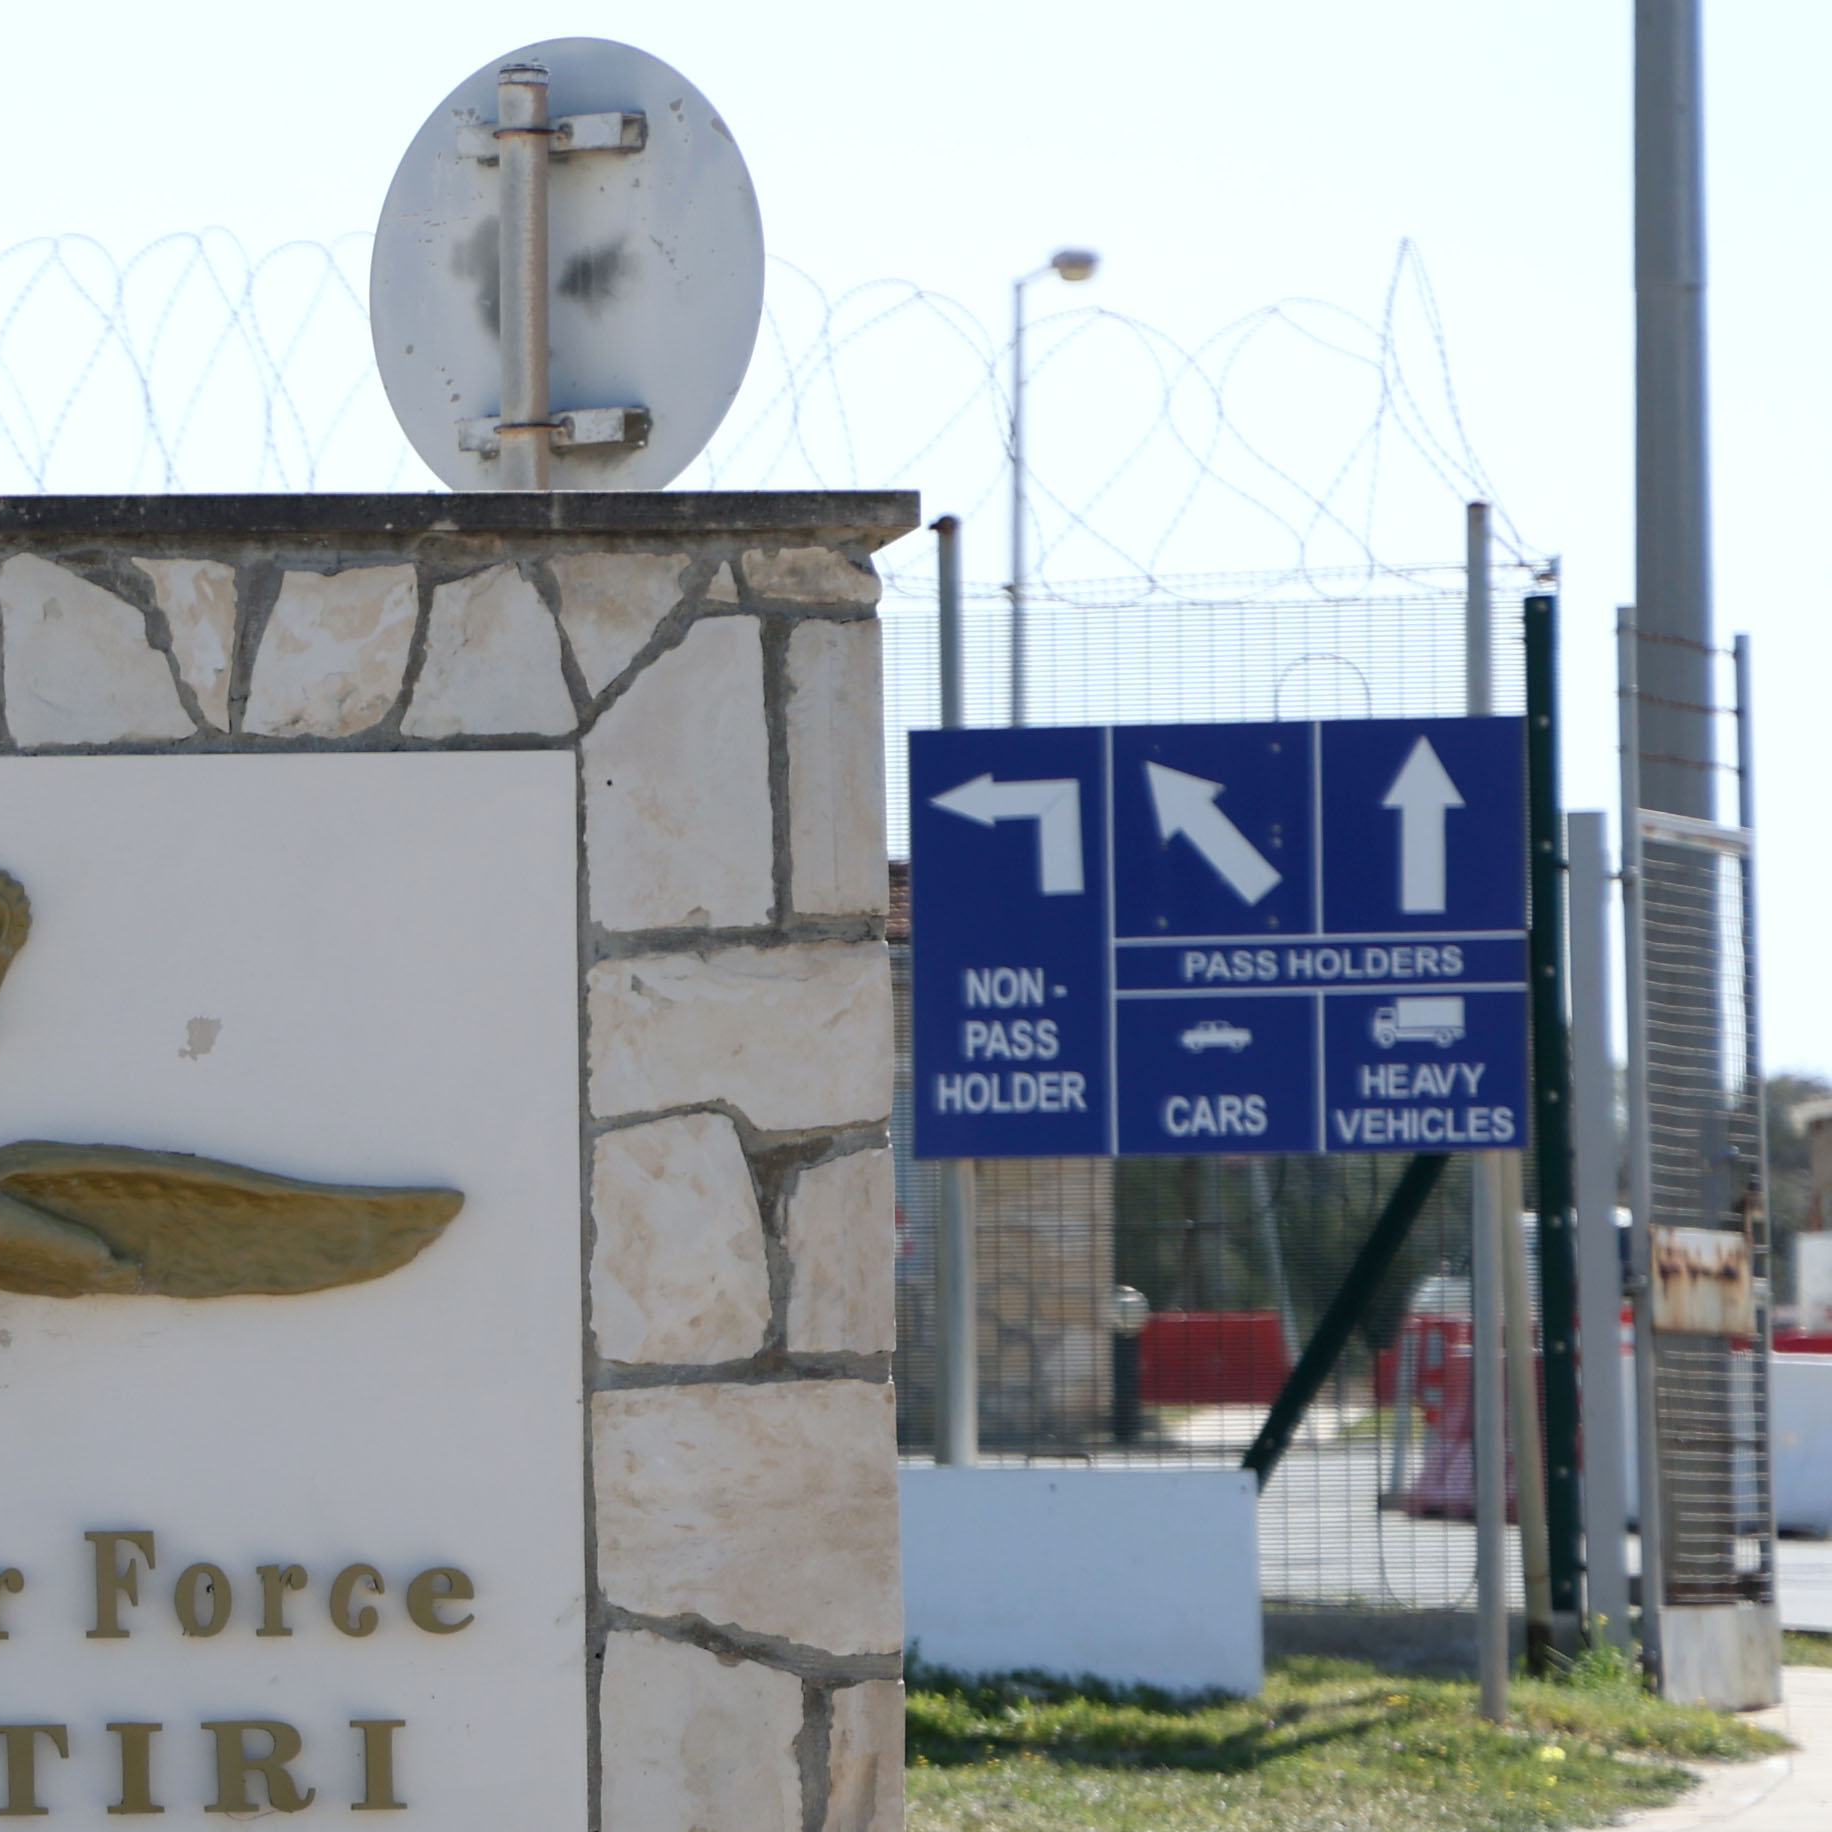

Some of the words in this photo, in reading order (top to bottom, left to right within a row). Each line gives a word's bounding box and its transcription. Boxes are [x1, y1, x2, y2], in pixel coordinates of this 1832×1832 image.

[1182, 949, 1278, 981] PASS
[1288, 945, 1465, 980] HOLDERS
[963, 1018, 1060, 1061] PASS
[936, 1070, 1087, 1115] HOLDER
[1360, 1062, 1485, 1098] HEAVY
[1164, 1094, 1268, 1136] CARS
[1336, 1106, 1516, 1143] VEHICLES
[83, 1530, 475, 1639] Force
